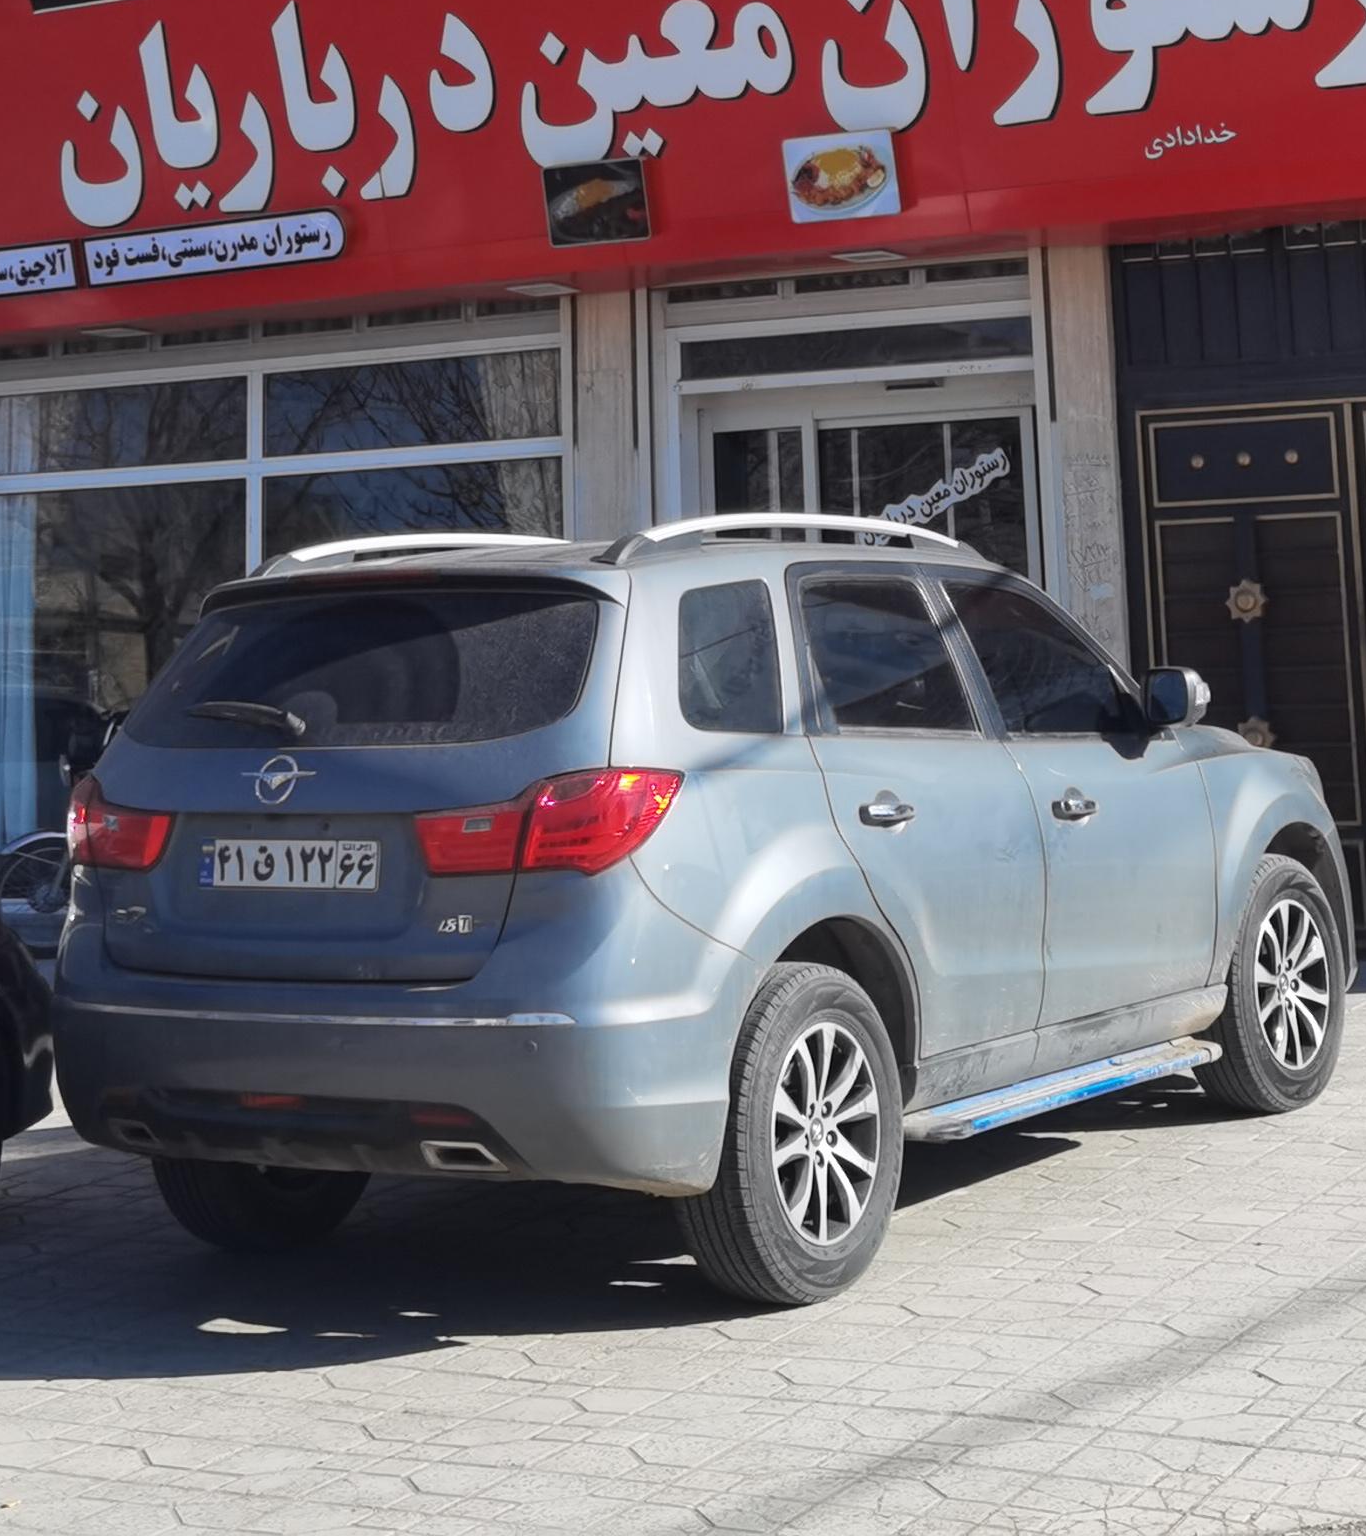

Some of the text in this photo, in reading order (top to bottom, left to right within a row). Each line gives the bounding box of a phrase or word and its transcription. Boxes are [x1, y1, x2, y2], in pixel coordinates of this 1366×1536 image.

[60, 0, 497, 228] درباریان
[1144, 122, 1238, 160] خدادادی
[263, 222, 332, 256] رستوران
[93, 242, 120, 276] فود
[953, 453, 1007, 495] رستوران
[920, 487, 951, 517] معین
